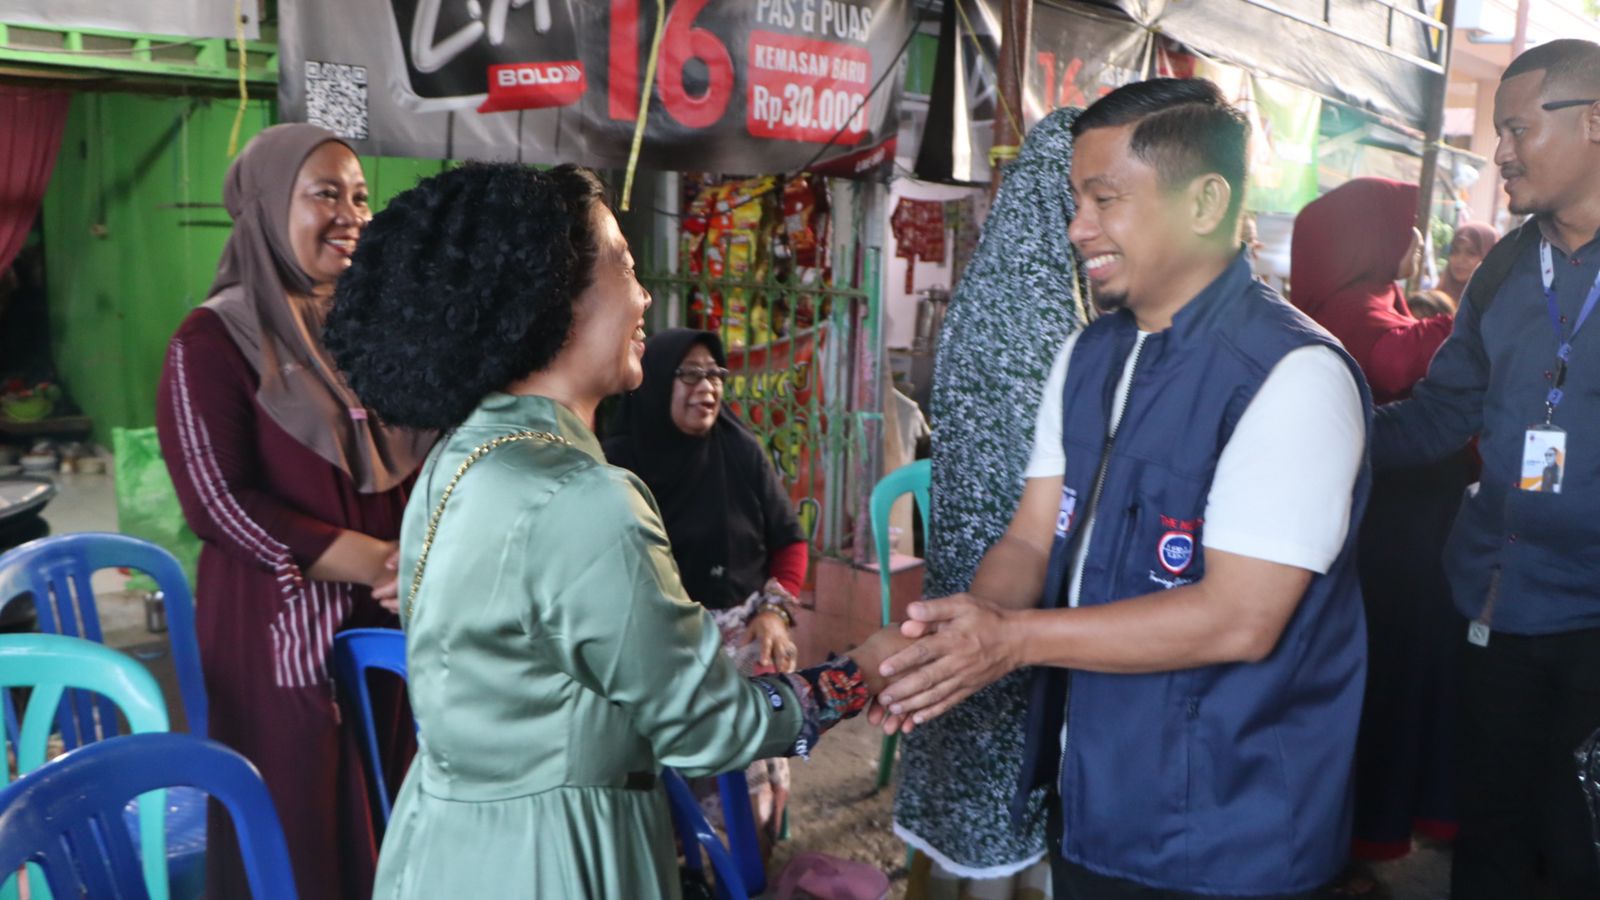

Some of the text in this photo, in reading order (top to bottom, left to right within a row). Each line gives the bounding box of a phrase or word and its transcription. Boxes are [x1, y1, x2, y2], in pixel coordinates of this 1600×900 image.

[756, 0, 873, 43] PAS & PUAS
[497, 66, 565, 87] BOLD
[608, 0, 735, 128] 16
[755, 44, 867, 84] KEMASAN BARU
[752, 83, 866, 135] Rp30.000
